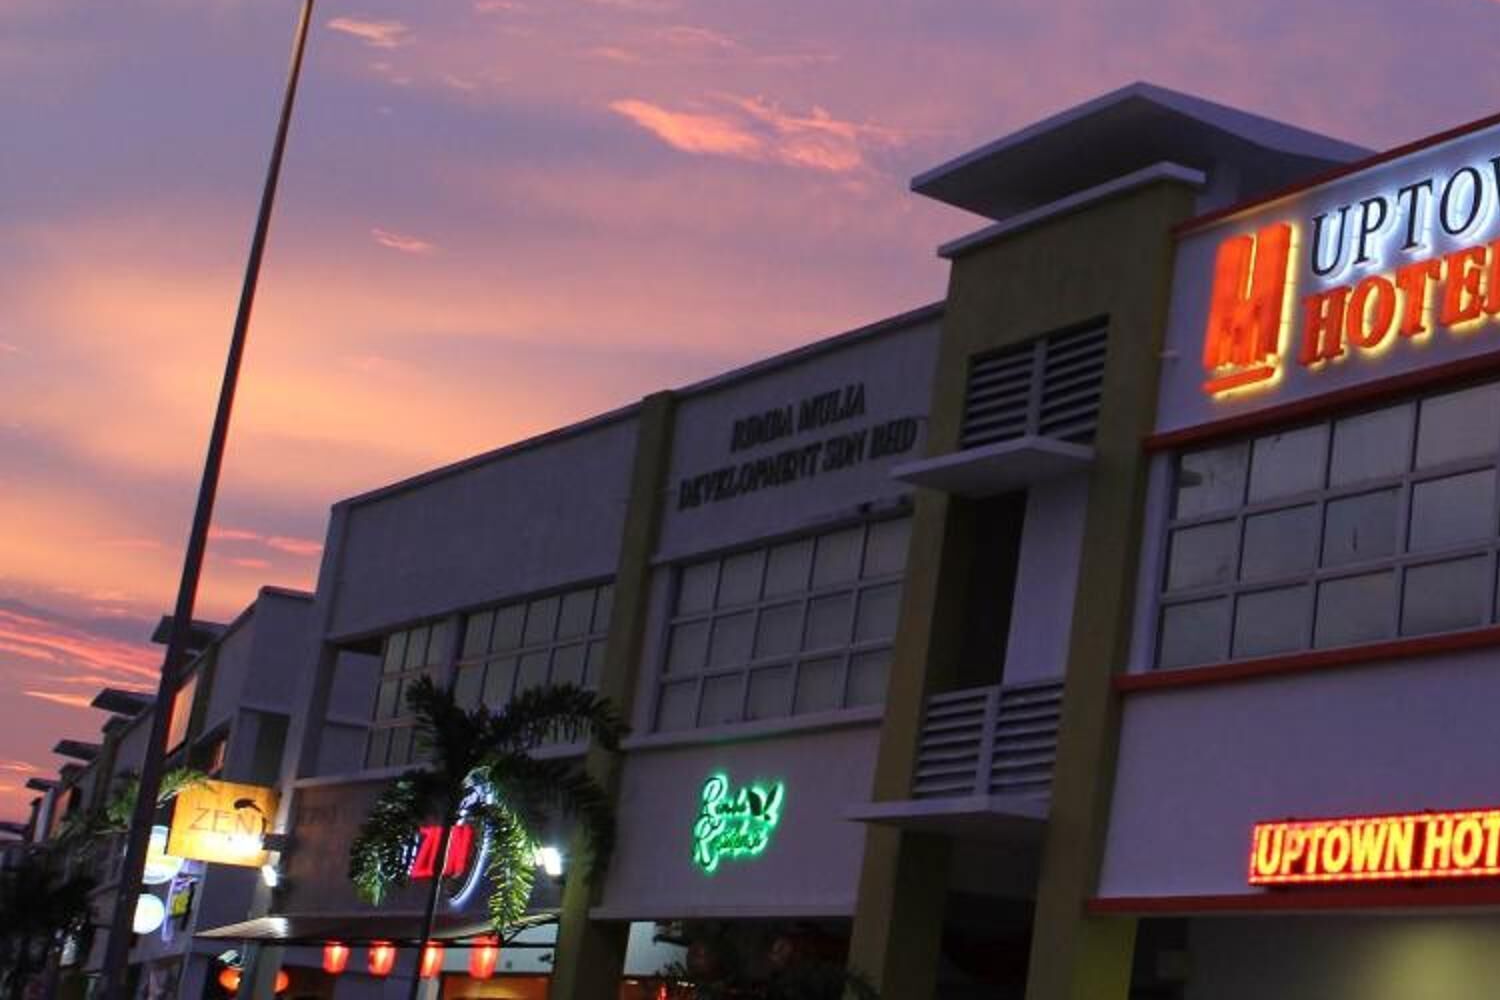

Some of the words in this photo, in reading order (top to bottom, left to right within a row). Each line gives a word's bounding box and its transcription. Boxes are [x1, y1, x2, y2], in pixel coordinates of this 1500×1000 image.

[796, 382, 865, 433] MULIA
[677, 440, 823, 512] DEVELOPMENT
[822, 428, 868, 473] SDN
[867, 416, 919, 460] BHD
[1255, 820, 1415, 876] UPTOWN
